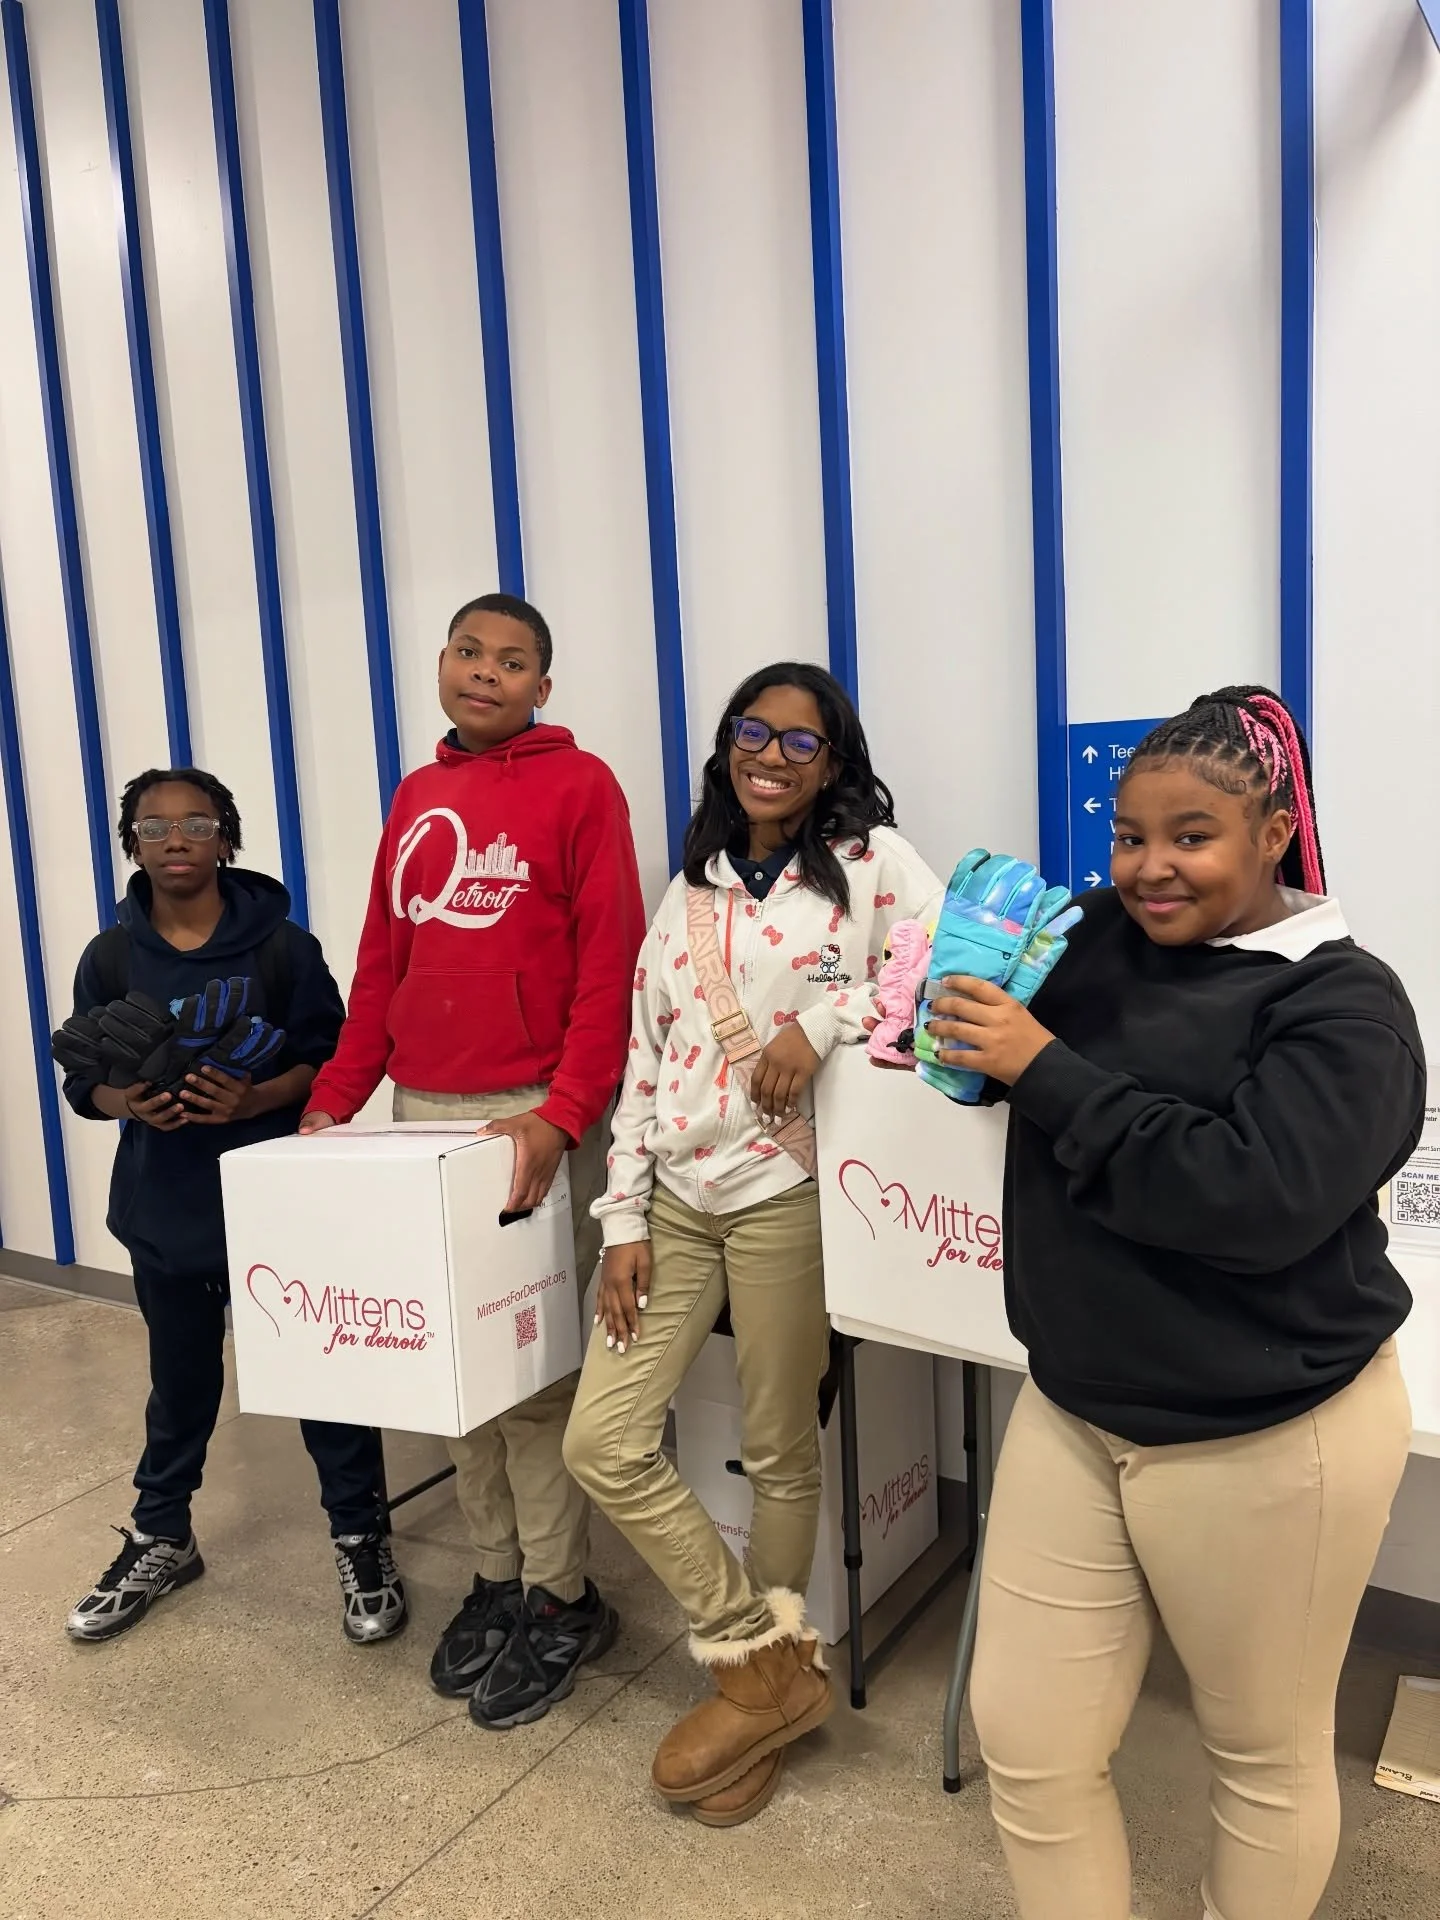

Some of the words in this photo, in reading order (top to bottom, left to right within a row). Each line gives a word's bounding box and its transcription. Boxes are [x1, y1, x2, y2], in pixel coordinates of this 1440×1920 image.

[1108, 744, 1137, 759] Tee
[1109, 766, 1125, 781] Hi
[807, 973, 833, 983] Hello
[833, 972, 852, 984] Kitty
[1401, 1171, 1424, 1180] SCAN
[1426, 1173, 1440, 1181] ME
[903, 1193, 1001, 1248] Mitte
[926, 1237, 971, 1268] for
[976, 1246, 1004, 1271] de
[302, 1285, 426, 1331] Mittens
[477, 1269, 567, 1321] MittensForDetroit.org
[323, 1323, 360, 1355] for
[364, 1325, 428, 1351] detroit
[872, 1454, 929, 1526] Mittens
[1378, 1765, 1413, 1782] BLANK
